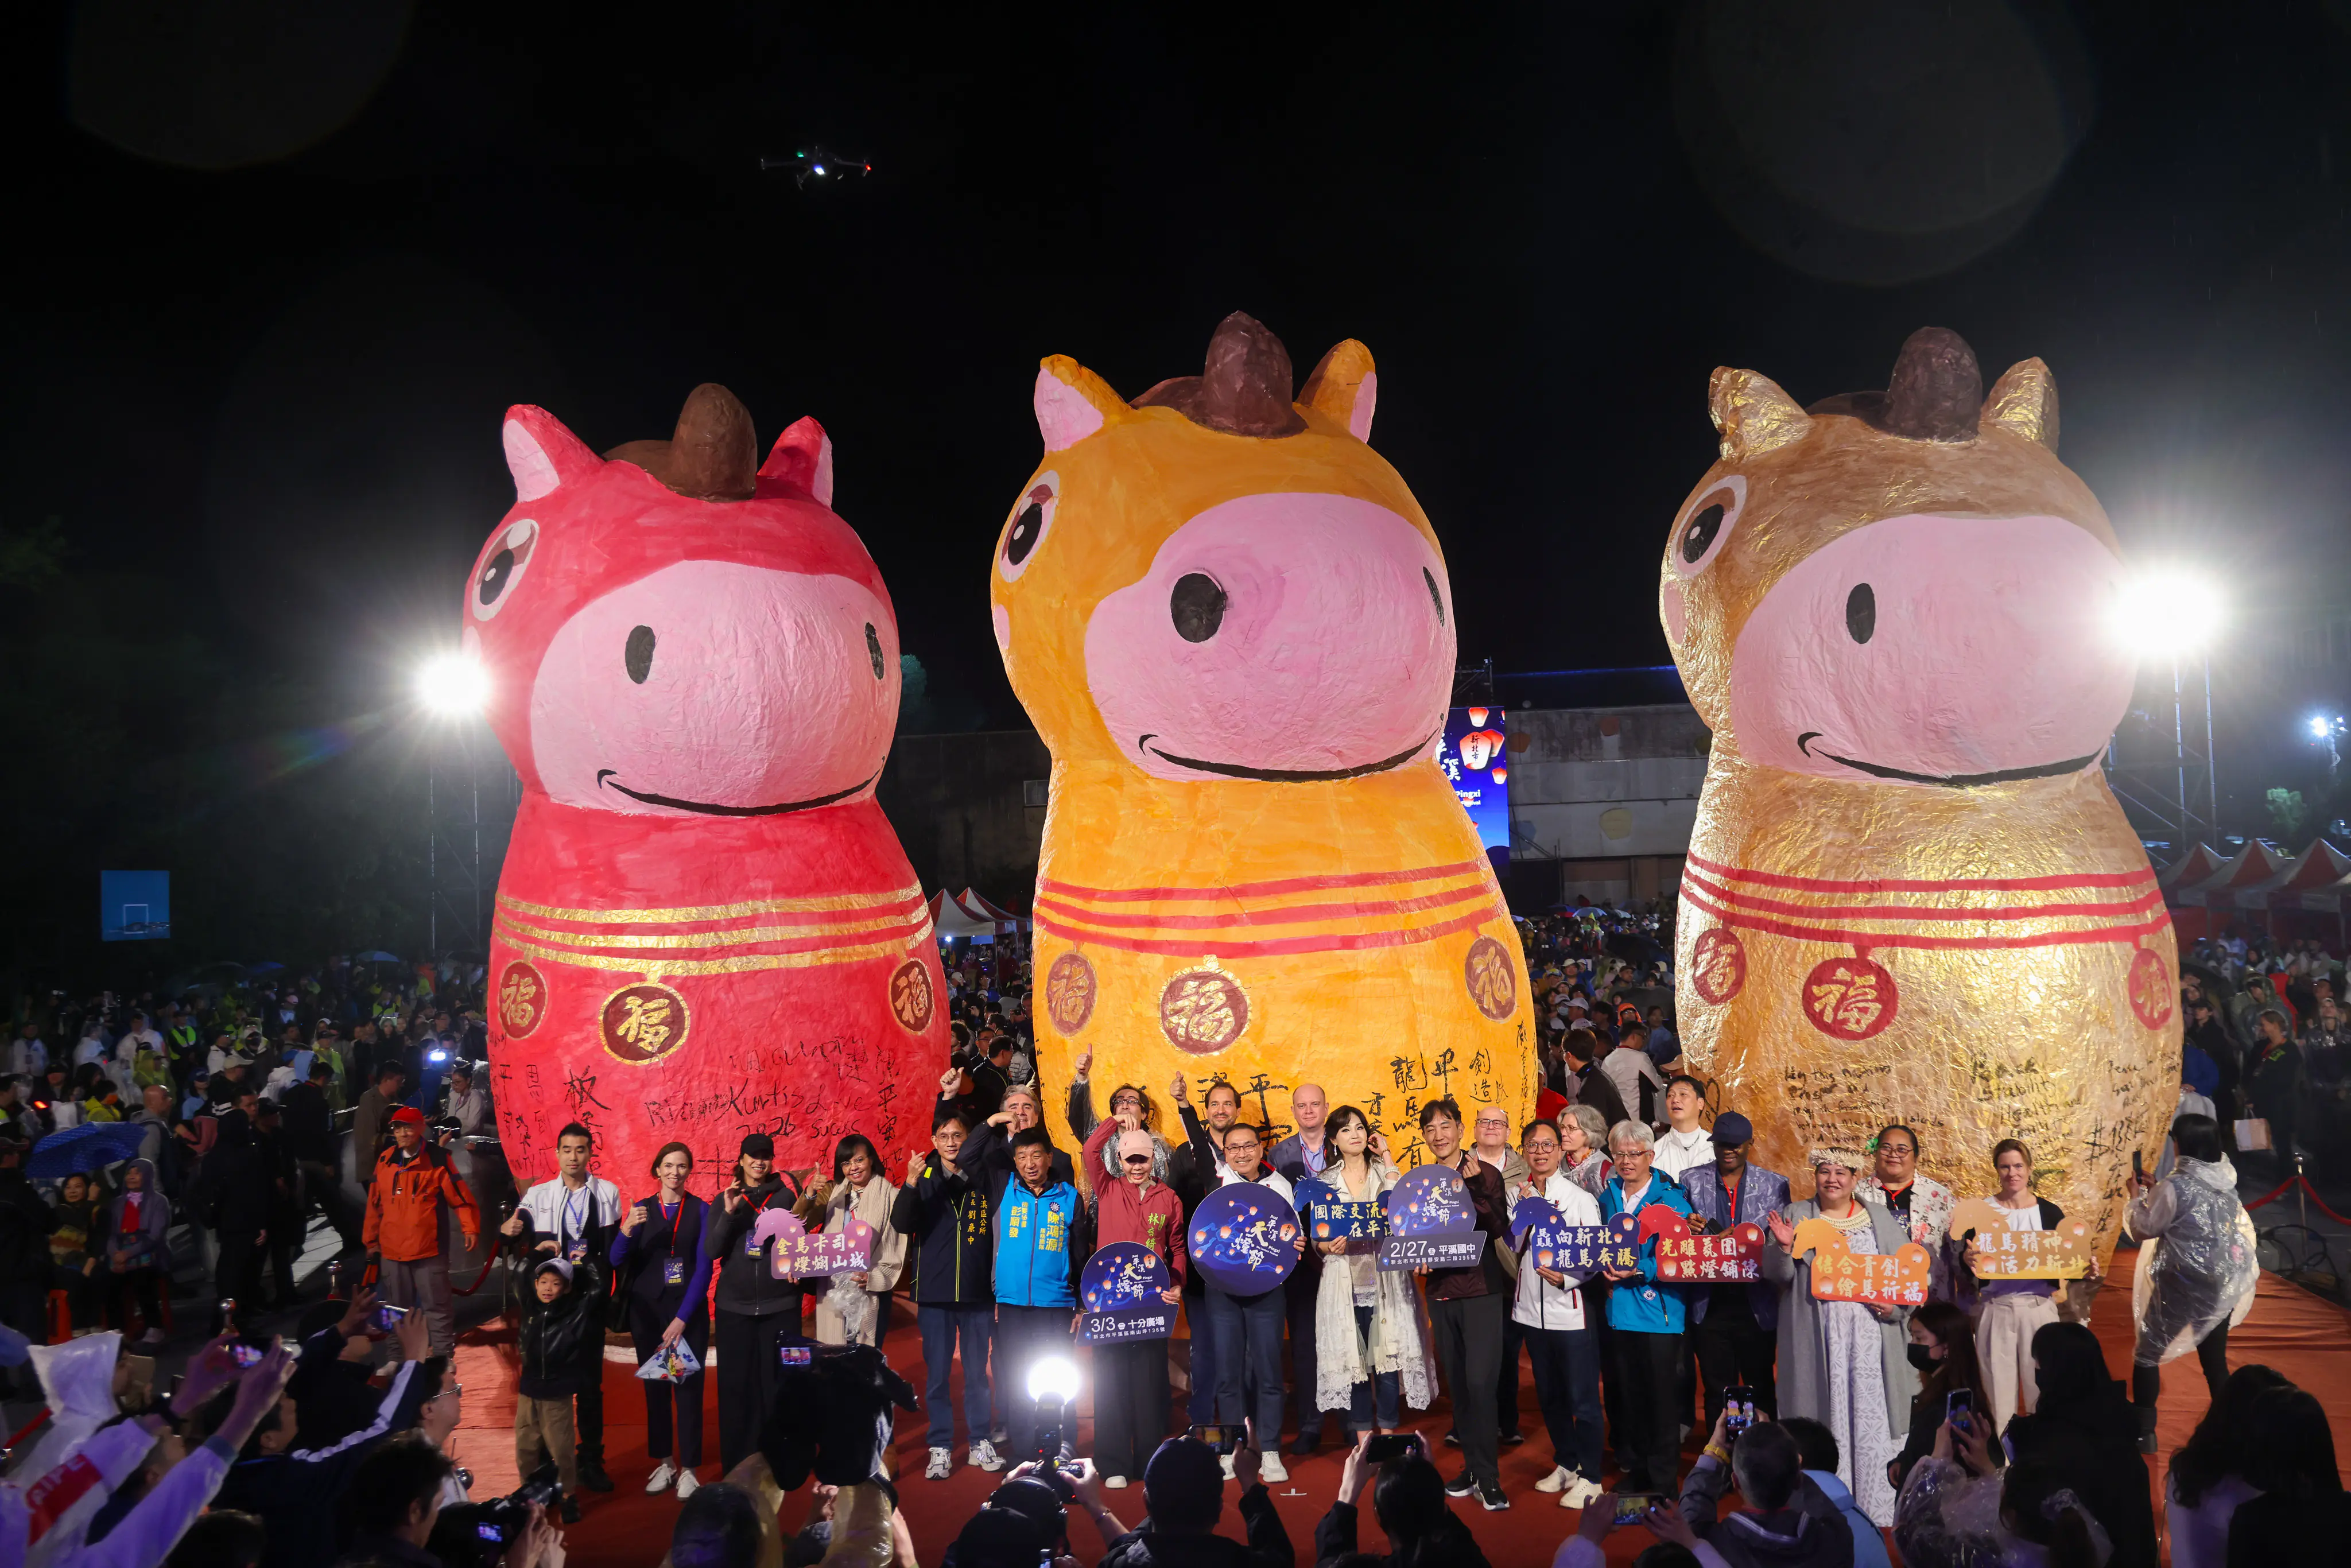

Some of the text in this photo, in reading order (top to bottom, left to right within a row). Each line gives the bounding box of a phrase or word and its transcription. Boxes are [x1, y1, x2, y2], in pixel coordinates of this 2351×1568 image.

[1471, 735, 1480, 762] 新北市
[502, 974, 537, 1027] 福
[894, 967, 928, 1024] 福
[1811, 967, 1882, 1033] 福
[1166, 980, 1235, 1042] 福
[616, 996, 670, 1054] 福
[1440, 1181, 1452, 1196] 平溪
[1314, 1202, 1382, 1220] 國際交流
[1422, 1186, 1450, 1226] 天燈節
[1009, 1206, 1022, 1238] 彭順發
[1045, 1211, 1060, 1252] 陳鴻源
[1266, 1220, 1279, 1241] 平溪
[777, 1233, 845, 1256] 金馬卡司
[1231, 1221, 1269, 1271] 天燈節
[1268, 1245, 1281, 1253] Pingxi
[1390, 1241, 1427, 1257] 2/27
[1438, 1243, 1476, 1255] 平溪國中
[1536, 1227, 1613, 1248] 驫向新北
[1661, 1237, 1737, 1257] 光雕氛圍
[1976, 1231, 2062, 1252] 龍馬精神
[1132, 1257, 1146, 1272] 平溪
[1555, 1247, 1637, 1268] 龍馬奔騰
[2000, 1254, 2086, 1275] 活力新北
[1115, 1263, 1144, 1301] 天燈節
[1837, 1276, 1923, 1302] 繪馬祈福
[1091, 1317, 1116, 1333] 3/3
[1127, 1316, 1165, 1329] 十分廣場
